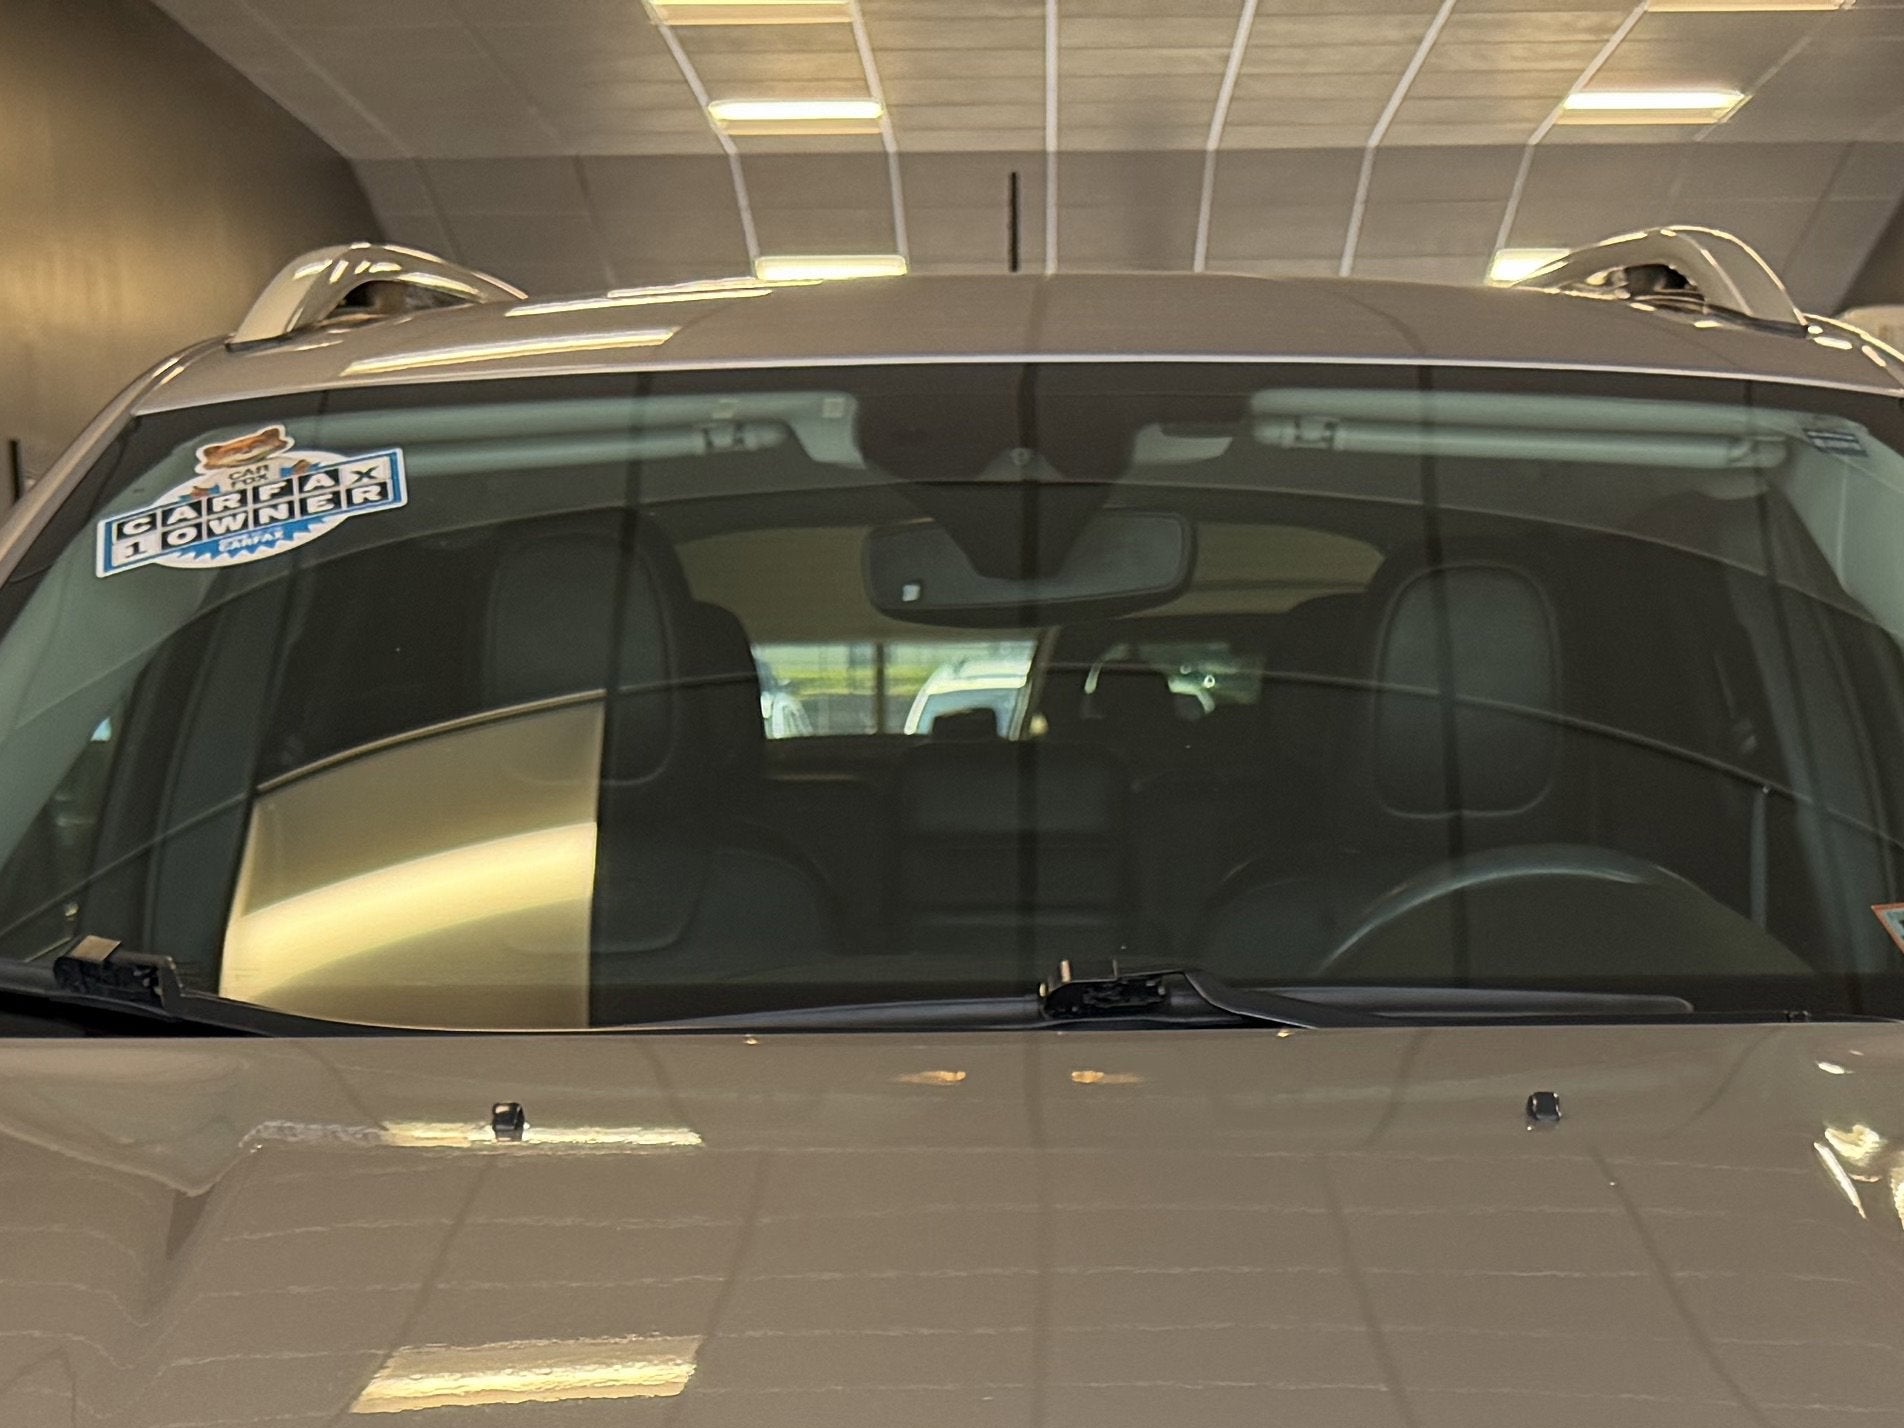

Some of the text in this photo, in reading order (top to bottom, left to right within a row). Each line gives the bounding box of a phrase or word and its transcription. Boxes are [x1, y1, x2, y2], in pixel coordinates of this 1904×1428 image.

[228, 464, 269, 481] CAR
[122, 464, 380, 536] CARFAX
[124, 484, 384, 559] 1 OWNER
[218, 530, 284, 552] CARFAX
